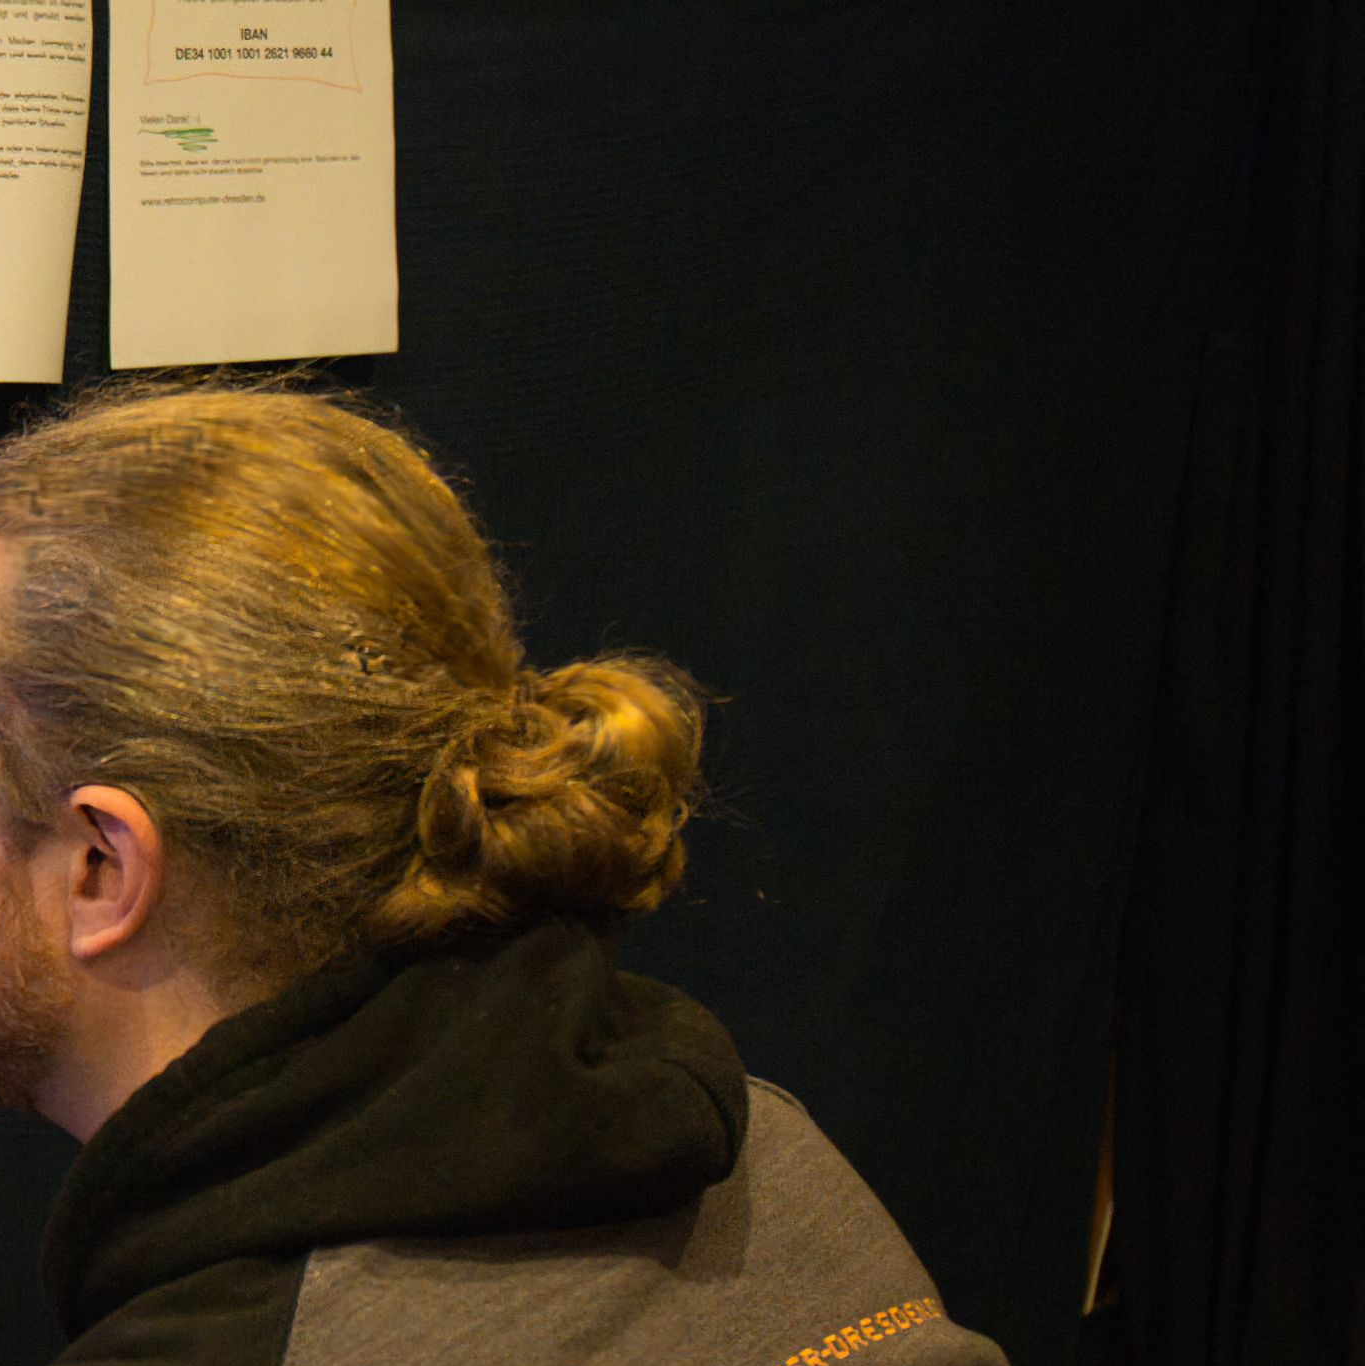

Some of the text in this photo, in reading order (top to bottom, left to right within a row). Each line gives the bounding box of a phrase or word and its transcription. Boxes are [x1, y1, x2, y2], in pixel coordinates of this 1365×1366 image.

[240, 27, 269, 41] IBAN
[175, 47, 205, 61] DE34
[208, 47, 232, 61] 1001
[236, 47, 261, 61] 1001
[320, 46, 334, 58] 44
